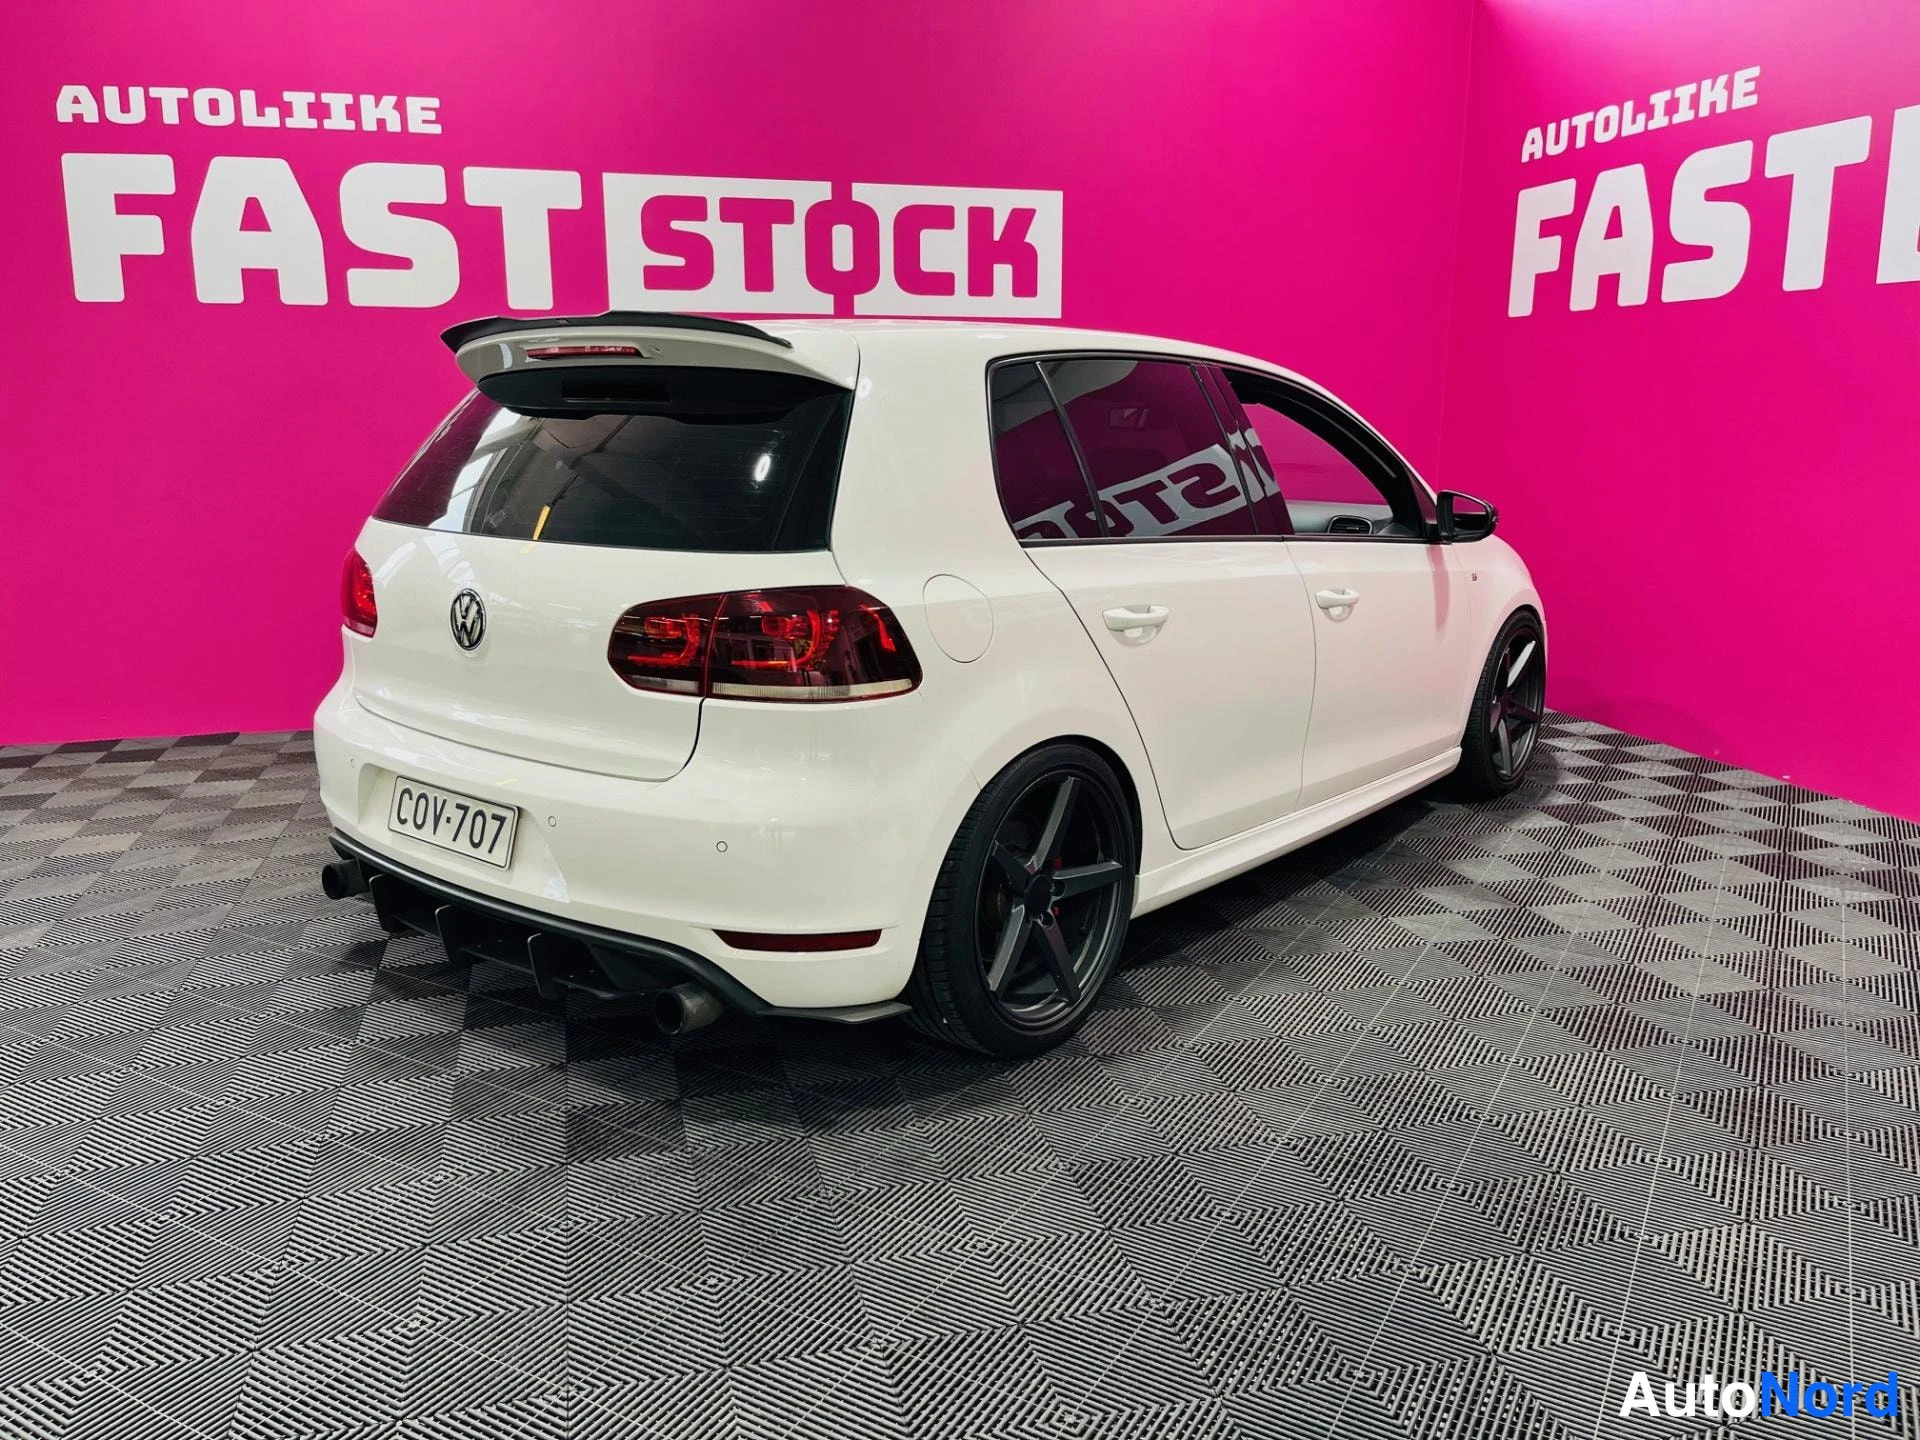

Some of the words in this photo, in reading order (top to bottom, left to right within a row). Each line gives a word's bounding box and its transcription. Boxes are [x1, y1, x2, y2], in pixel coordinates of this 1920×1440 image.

[56, 84, 443, 134] AUTOLIIKE
[1521, 65, 1761, 163] AUTOLIIKE
[61, 152, 583, 310] FAST
[640, 194, 1039, 298] STOCK
[1508, 115, 1873, 318] FAST
[396, 787, 507, 854] COV-707
